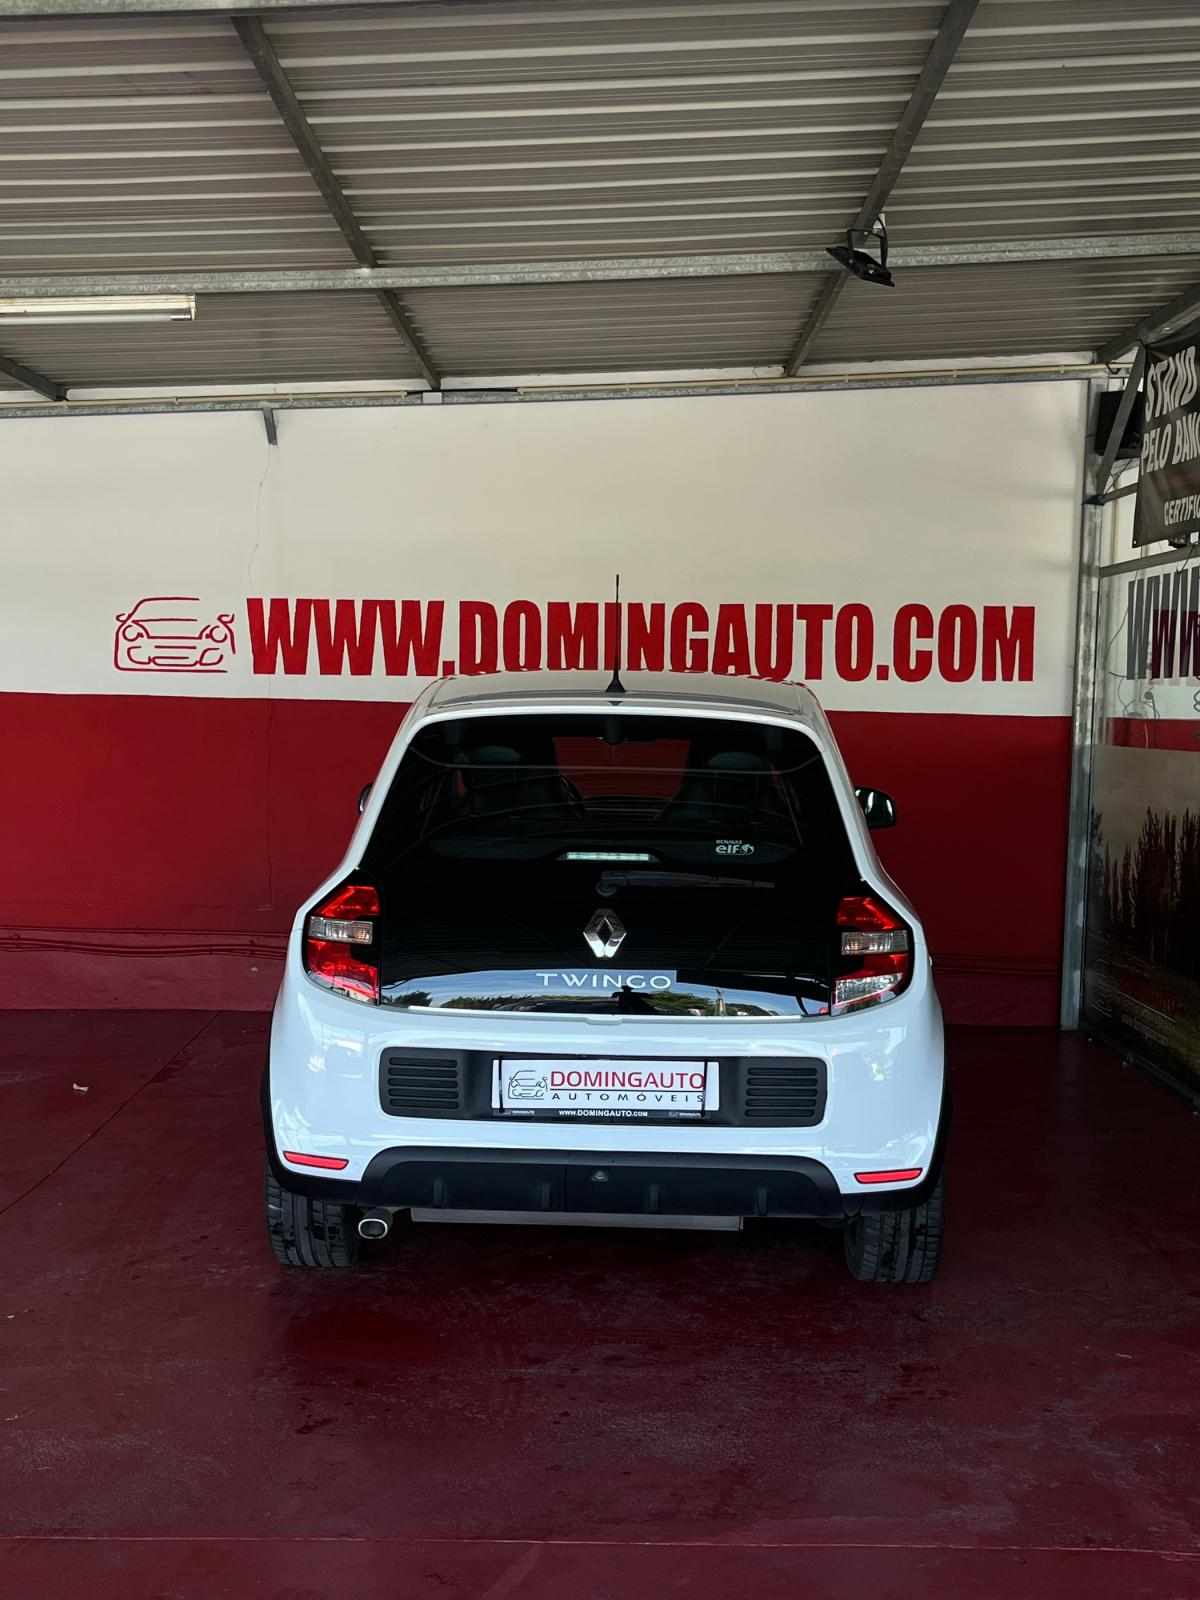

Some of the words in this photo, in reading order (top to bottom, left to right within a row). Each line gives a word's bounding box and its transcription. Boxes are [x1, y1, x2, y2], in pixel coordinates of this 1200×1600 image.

[1145, 345, 1196, 422] STAND
[1140, 423, 1172, 476] PELO
[247, 598, 1034, 681] WWW.DOMINGAUTO.COM
[535, 972, 672, 990] TWINGO
[551, 1070, 705, 1089] DOMINGAUTO
